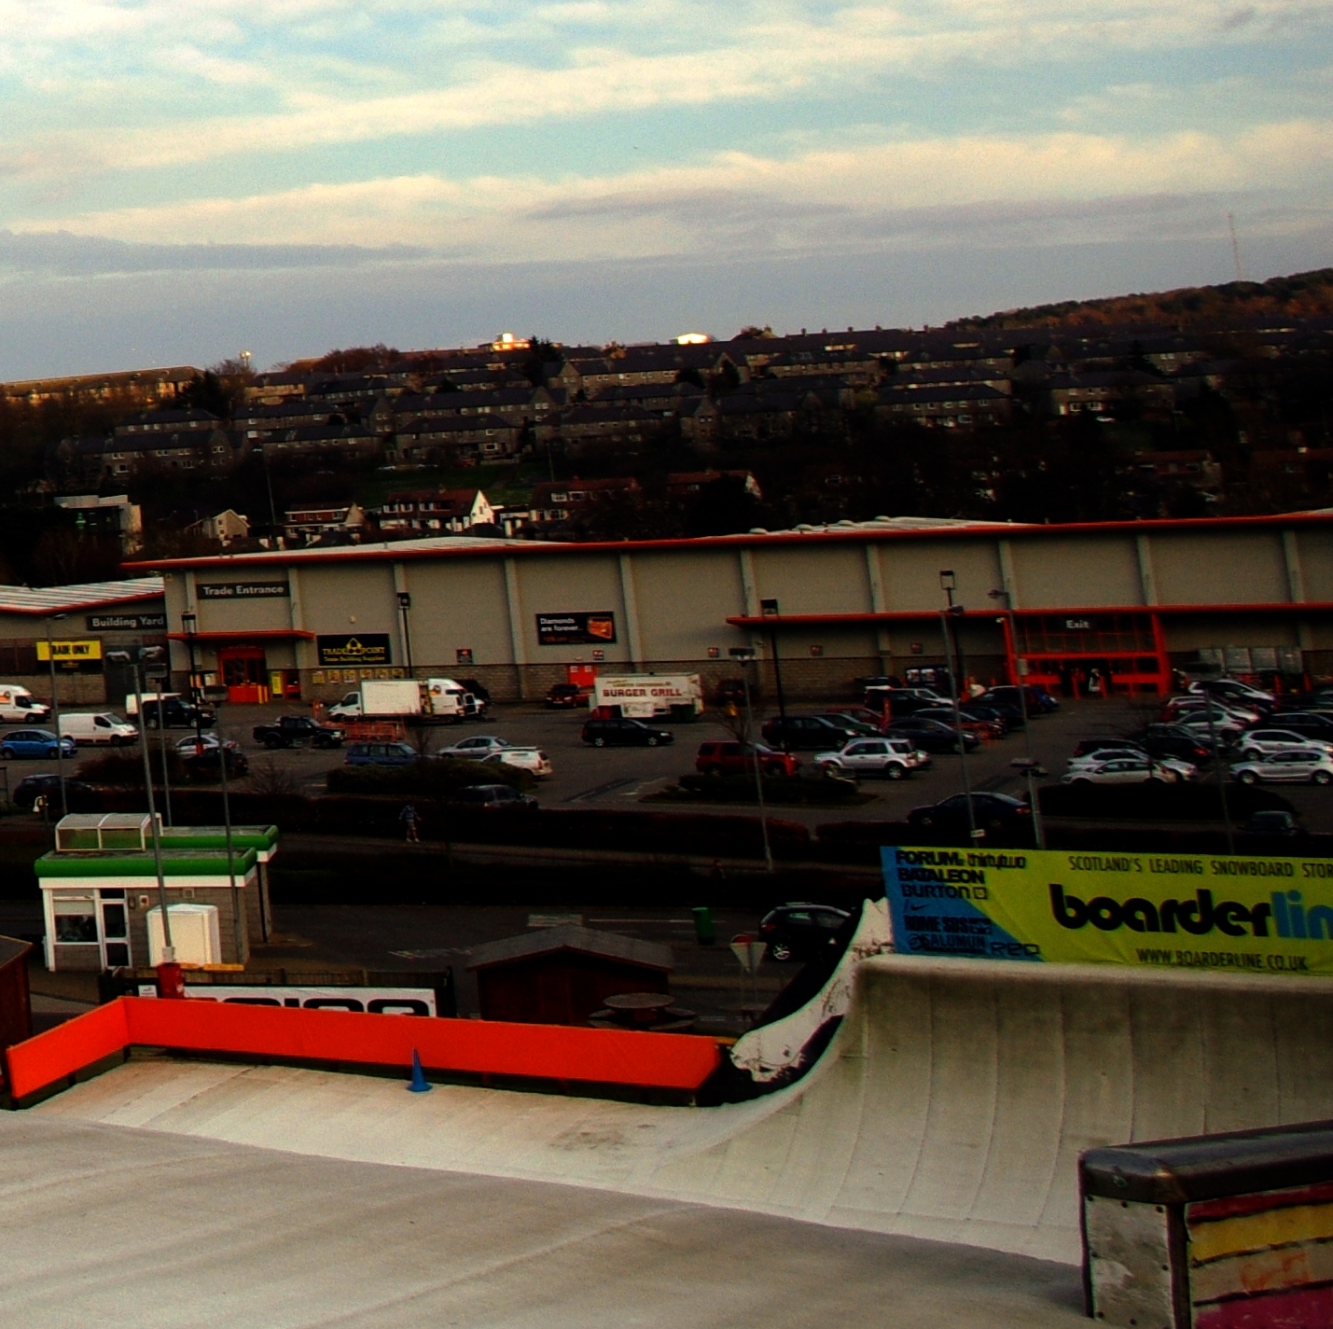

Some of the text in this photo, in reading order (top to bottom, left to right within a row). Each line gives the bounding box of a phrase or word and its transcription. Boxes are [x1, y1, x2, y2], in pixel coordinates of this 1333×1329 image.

[202, 584, 284, 596] Trade Entrance
[91, 615, 164, 628] Building Yard
[1065, 619, 1090, 630] Exit
[51, 644, 70, 655] RADE
[602, 688, 682, 697] BURGER GRILL
[895, 850, 959, 866] FORUM
[1068, 855, 1142, 873] SCOTLAND'S
[1149, 858, 1203, 874] LEADING
[1210, 860, 1294, 878] SNOWBOARD
[897, 867, 985, 884] BATALEON
[900, 884, 971, 899] BURTON
